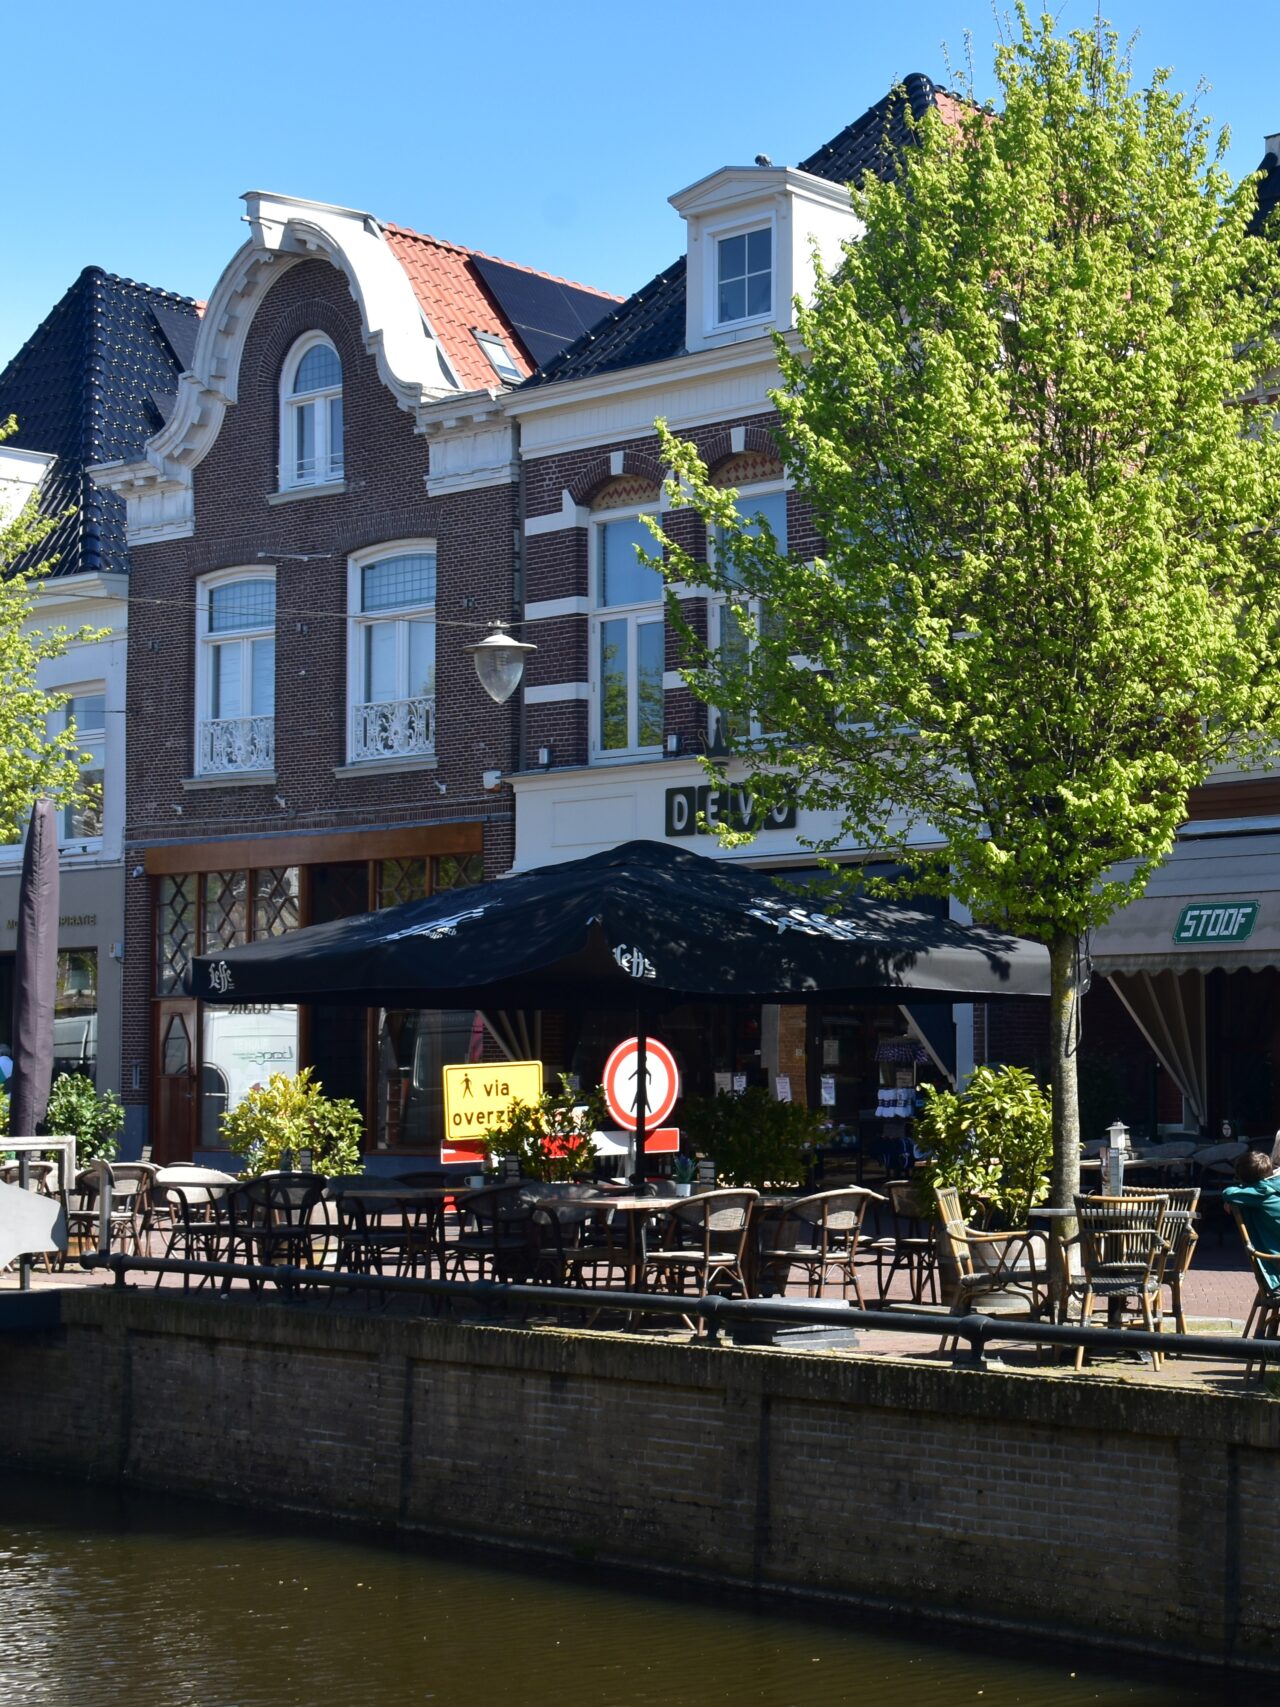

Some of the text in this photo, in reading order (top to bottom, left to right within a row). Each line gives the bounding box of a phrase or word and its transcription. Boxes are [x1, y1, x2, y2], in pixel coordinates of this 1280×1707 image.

[1180, 907, 1253, 937] STOOF
[208, 960, 232, 994] Leffe
[484, 1080, 510, 1097] via
